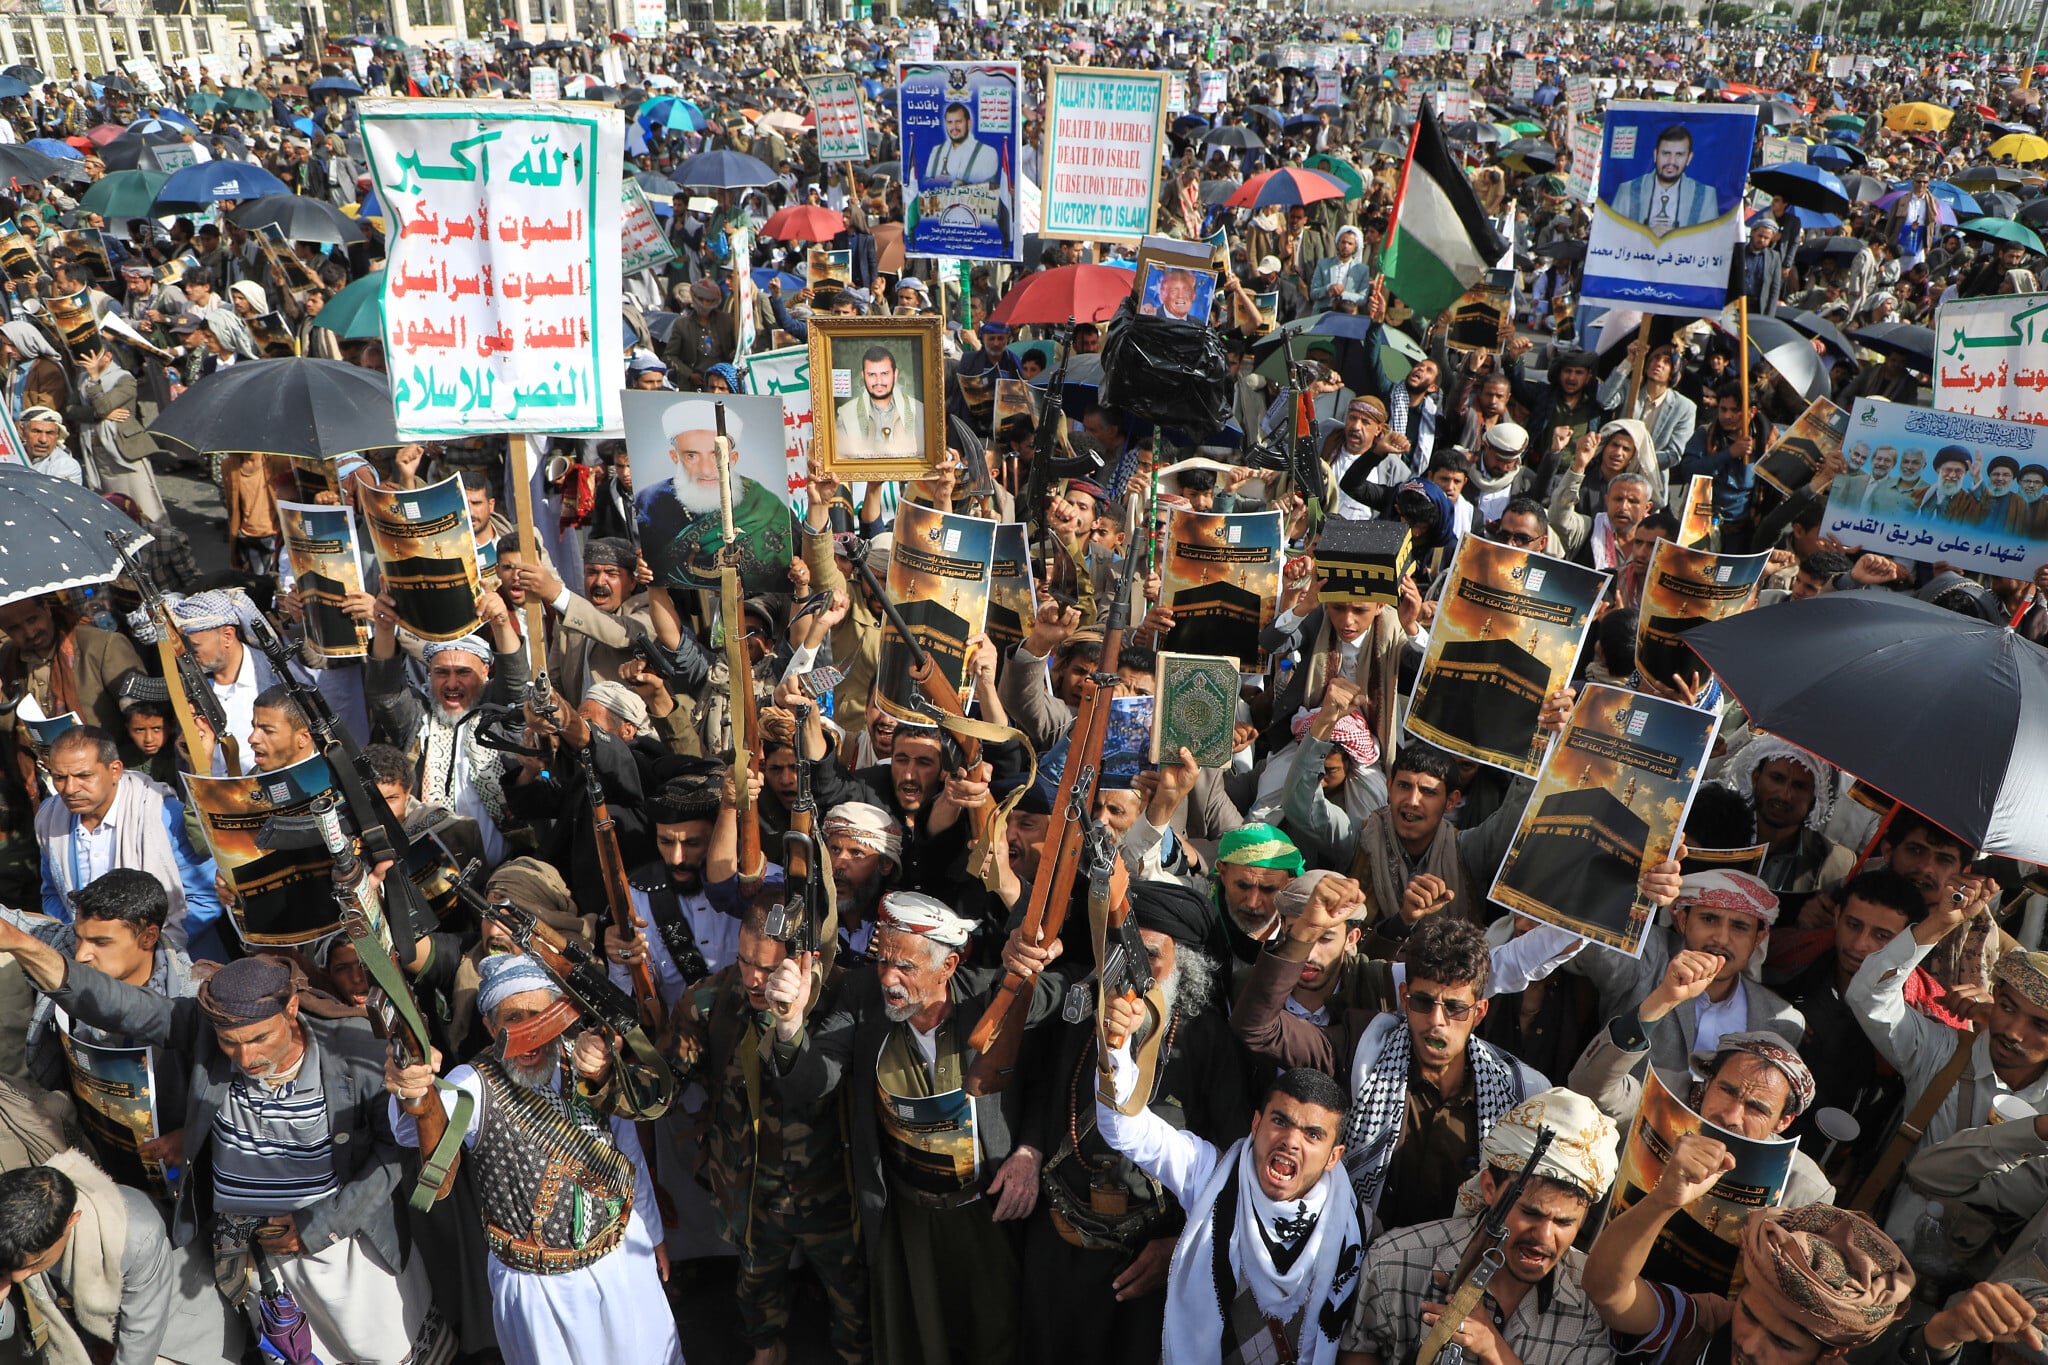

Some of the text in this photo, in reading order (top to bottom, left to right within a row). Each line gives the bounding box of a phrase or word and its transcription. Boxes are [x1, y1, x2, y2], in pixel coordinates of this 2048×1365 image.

[1060, 80, 1086, 109] ALLAH
[1088, 82, 1096, 109] IS
[1098, 83, 1114, 110] THE
[1115, 84, 1158, 113] GREATEST
[1058, 118, 1151, 144] DEATH TO AMERICA
[386, 122, 583, 196] الله أكبر
[1057, 145, 1141, 169] DEATH TO ISRAEL
[1055, 173, 1147, 198] CURSE UPON THE JEWS
[1054, 201, 1097, 225] VICTORY
[1099, 204, 1113, 226] TO
[1115, 205, 1147, 229] ISLAM
[498, 208, 583, 250] الموت
[1590, 247, 1613, 256] محمد
[1633, 251, 1655, 261] محمد
[1656, 252, 1673, 265] في
[1674, 253, 1696, 266] الحق
[1697, 256, 1709, 269] إن
[392, 256, 584, 306] الموت لإسرائيل
[392, 315, 585, 358] اللعنة على اليهود
[1942, 299, 2048, 361] أكبر
[1941, 358, 2009, 393] لأمريكا
[395, 360, 588, 425] النصر للإسلام
[1831, 518, 2026, 563] شهداء على طريق القدس
[1462, 590, 1569, 623] المجرم الصهيوني ترامب لمكة المكرمة
[1588, 744, 1602, 753] لمكة
[1601, 749, 1618, 759] ترامب
[1617, 754, 1650, 767] الصهيوني
[1649, 764, 1673, 776] المجرم
[1734, 1195, 1761, 1204] المجرم
